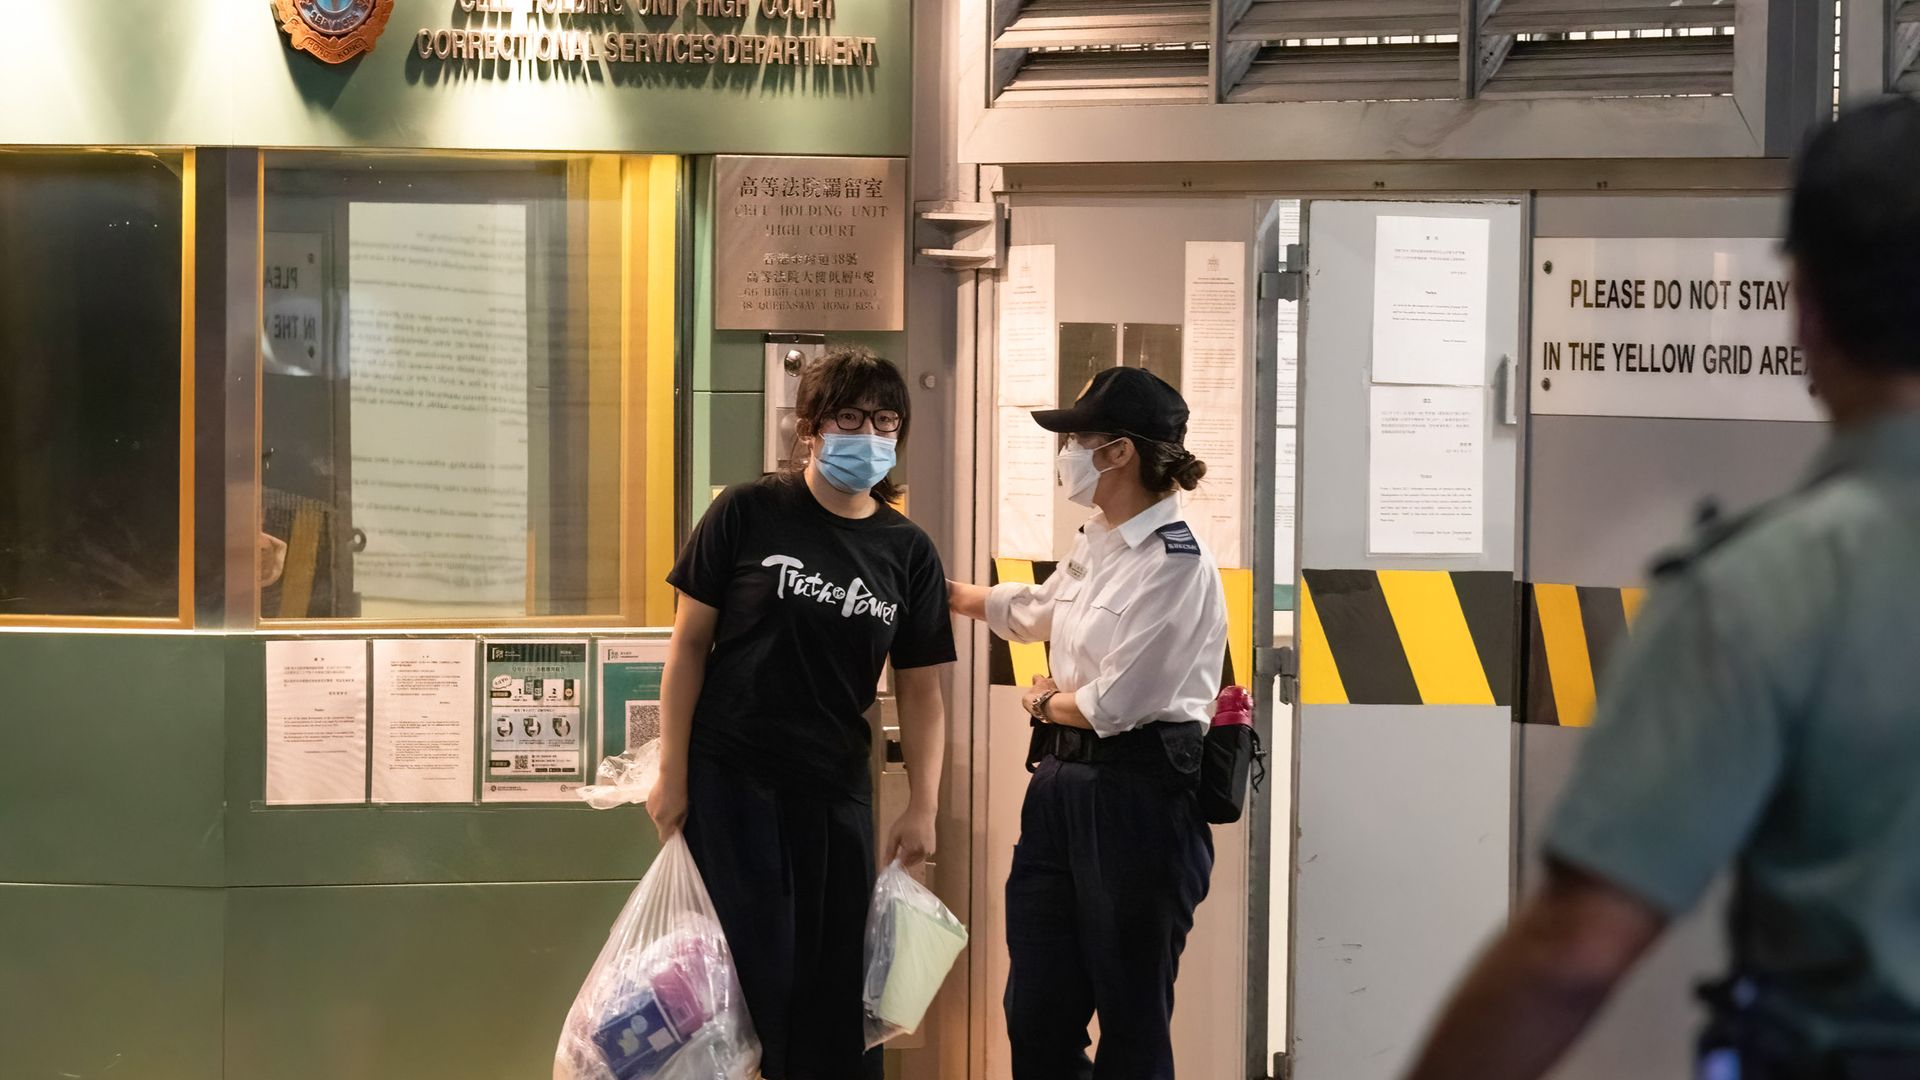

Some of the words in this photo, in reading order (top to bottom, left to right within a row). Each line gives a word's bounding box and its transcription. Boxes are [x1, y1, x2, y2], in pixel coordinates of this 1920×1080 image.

[417, 28, 600, 62] CORRECTIONAL
[604, 32, 720, 64] SERVICES
[722, 34, 877, 66] DEPARTMENT
[779, 204, 843, 218] HOLDING
[851, 204, 889, 218] UNIT
[766, 223, 801, 237] HIGH
[808, 224, 856, 238] COURT
[1570, 278, 1646, 309] PLEASE
[1653, 279, 1682, 309] DO
[1689, 280, 1731, 310] NOT
[1738, 280, 1793, 311] STAY
[1543, 341, 1561, 371] IN
[1568, 342, 1605, 372] THE
[1612, 342, 1696, 373] YELLOW
[1703, 344, 1752, 375] GRID
[1759, 345, 1810, 376] ARE
[761, 554, 837, 605] Truth
[841, 577, 898, 626] Power
